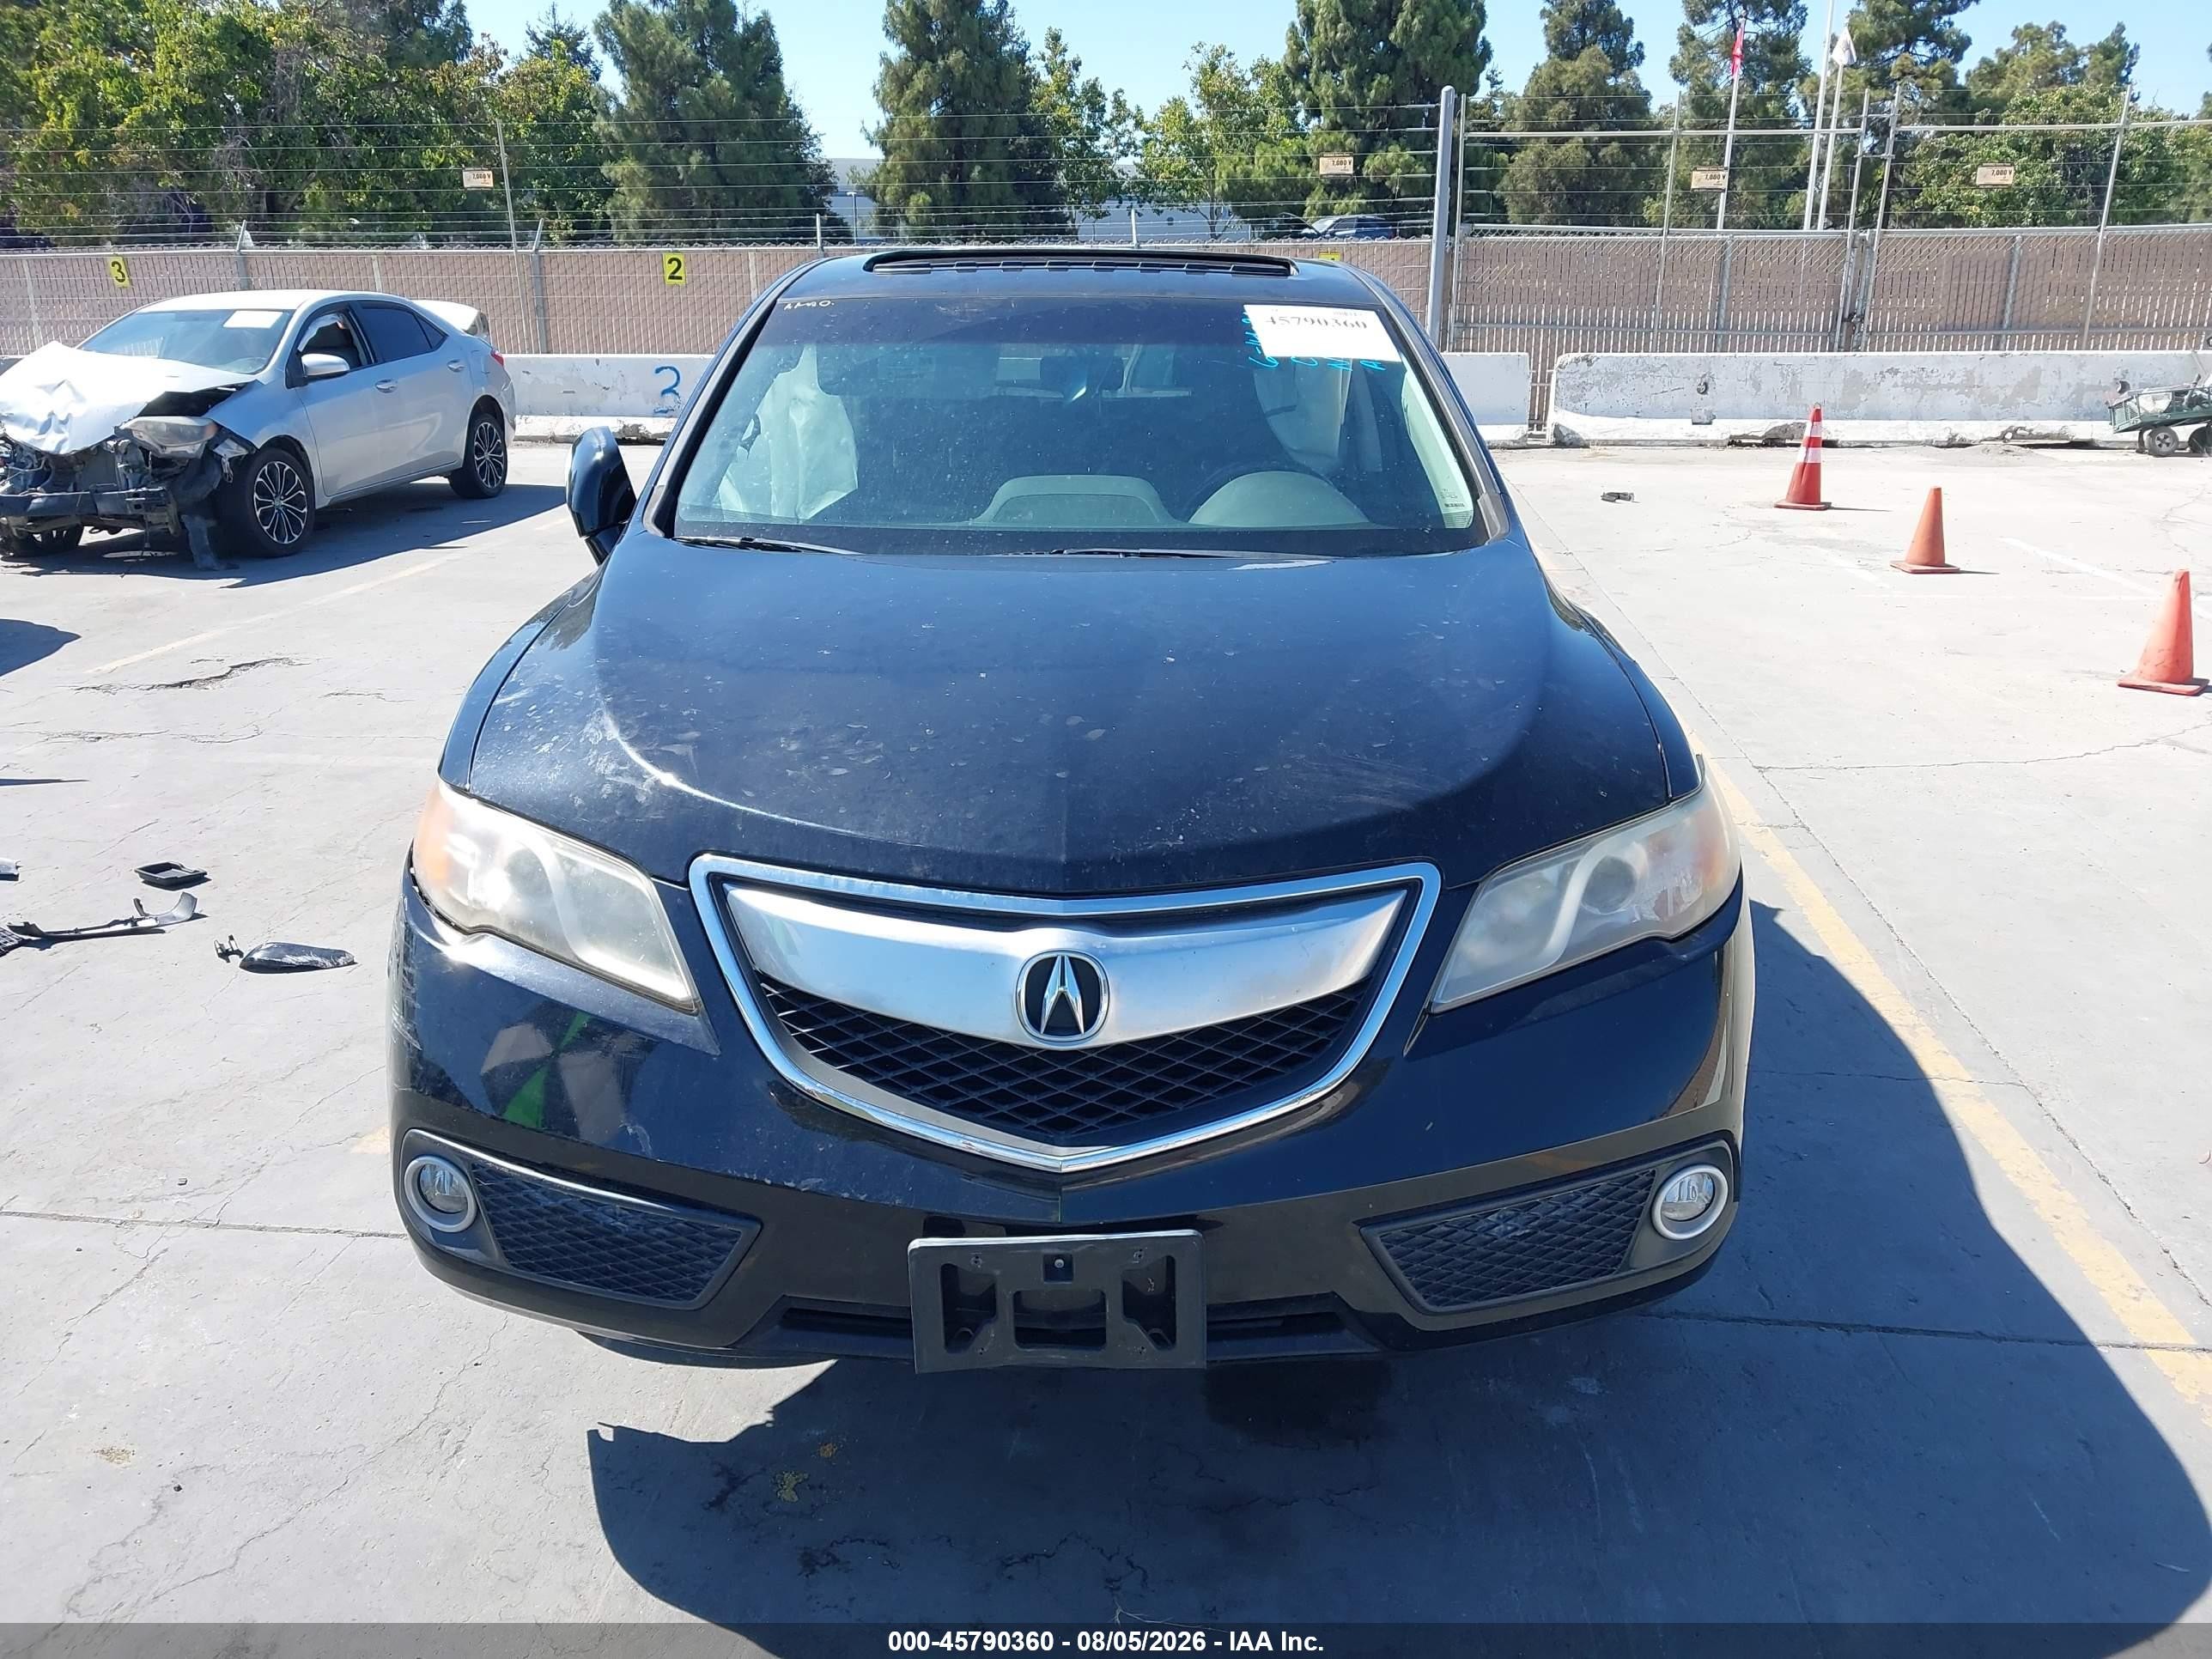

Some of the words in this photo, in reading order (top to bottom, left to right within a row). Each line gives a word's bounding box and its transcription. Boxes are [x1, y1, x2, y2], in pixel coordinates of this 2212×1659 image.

[112, 261, 125, 283] 3
[667, 258, 683, 280] 2
[1265, 315, 1368, 329] 45790360
